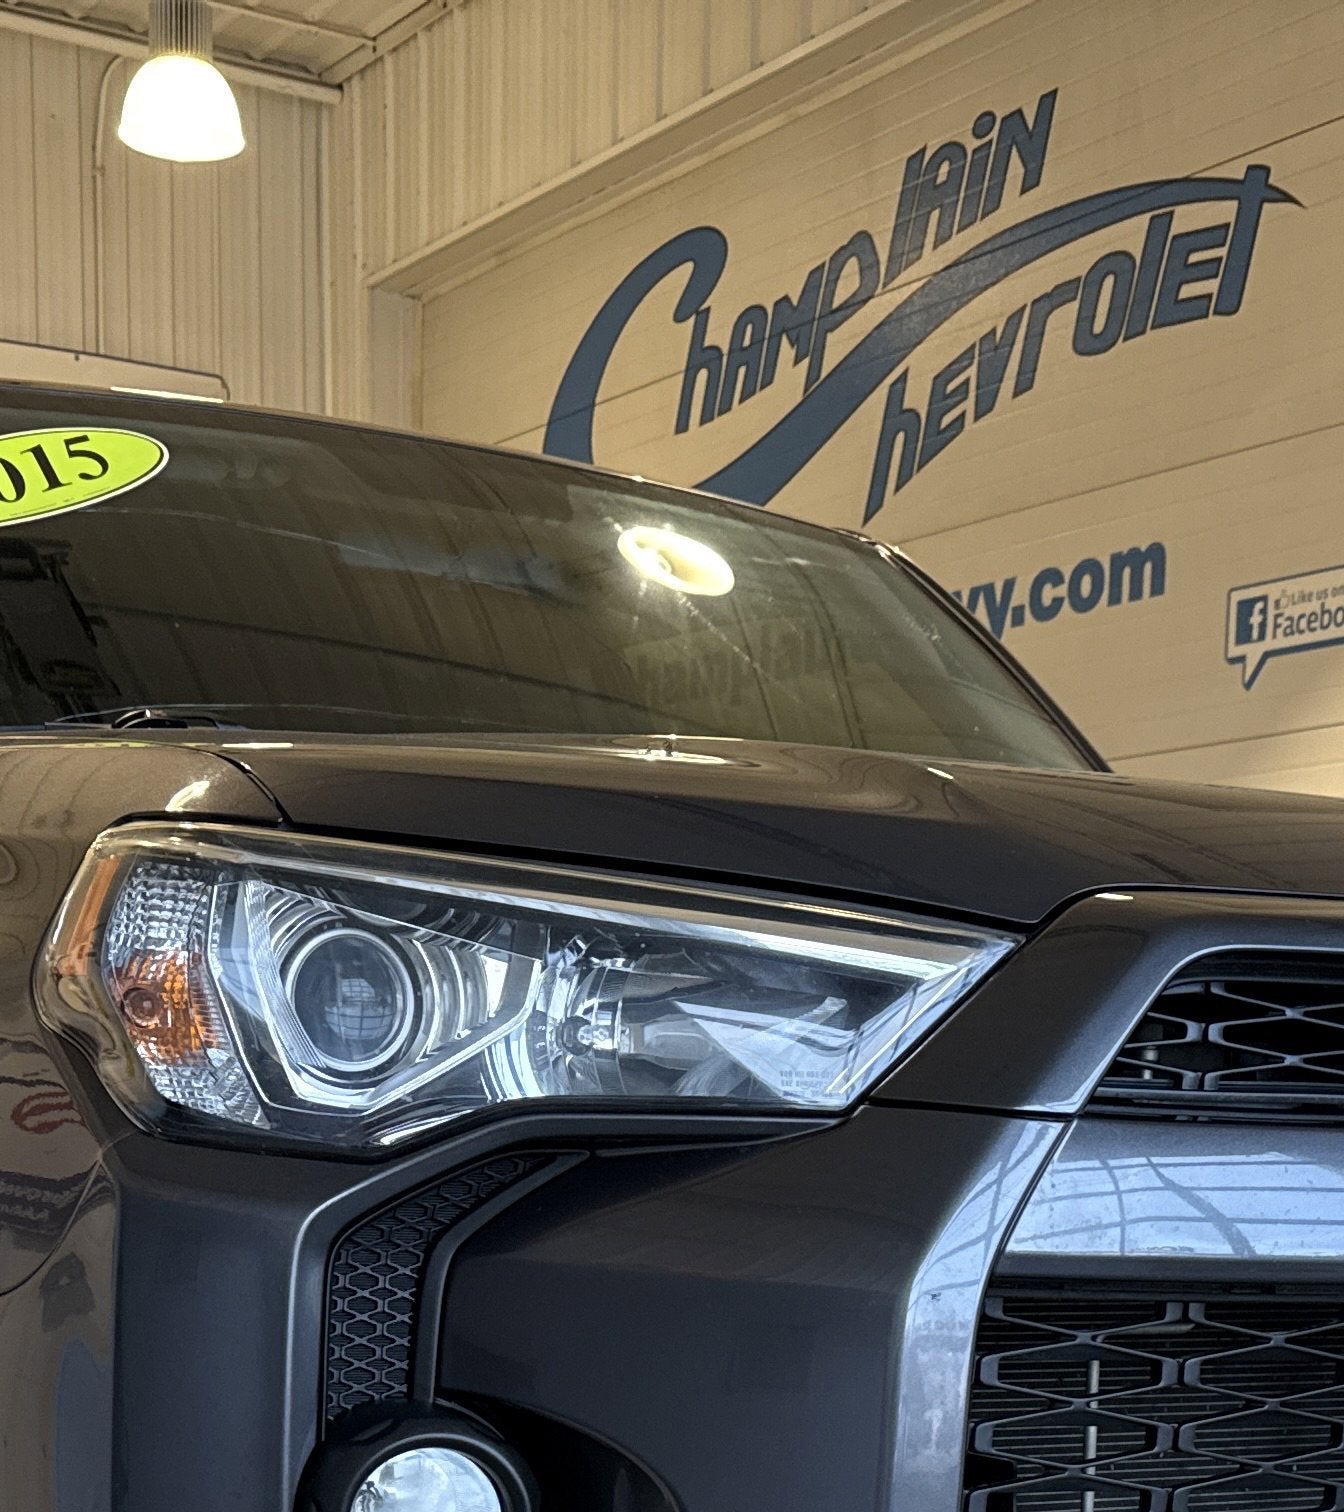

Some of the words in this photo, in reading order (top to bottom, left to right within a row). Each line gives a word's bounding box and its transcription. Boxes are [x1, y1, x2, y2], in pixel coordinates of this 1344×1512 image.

[949, 541, 1166, 640] vy.com
[1292, 589, 1314, 606] Like
[1316, 588, 1329, 600] us
